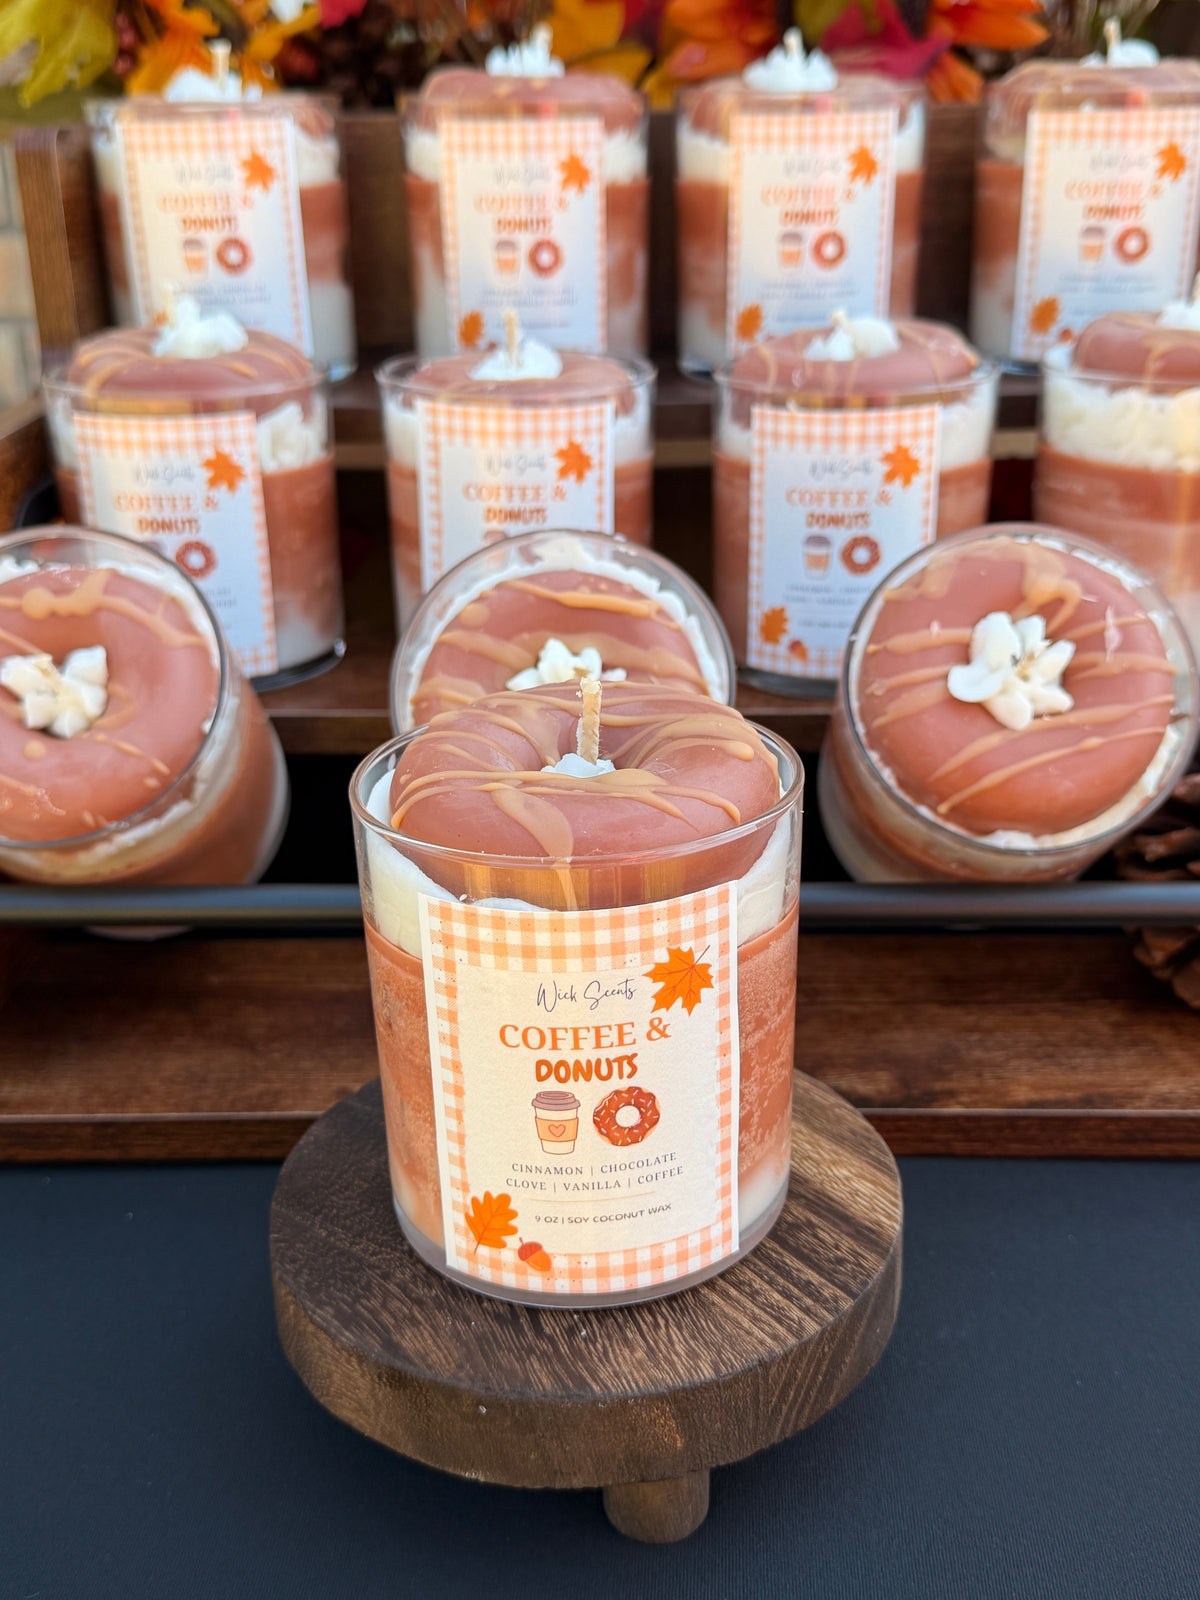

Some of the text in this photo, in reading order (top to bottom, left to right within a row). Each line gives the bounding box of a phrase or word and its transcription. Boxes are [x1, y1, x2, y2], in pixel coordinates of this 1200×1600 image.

[536, 978, 637, 1012] Wick Scents
[499, 1016, 671, 1051] COFFEE &
[535, 1052, 639, 1083] DONUTS
[512, 1162, 584, 1176] CINNAMON
[600, 1152, 678, 1174] CHOCOLATE
[505, 1178, 547, 1191] CLOVE
[563, 1179, 622, 1191] VANILLA
[637, 1166, 684, 1184] COFFEE
[535, 1215, 541, 1223] 9
[544, 1215, 559, 1224] OZ
[568, 1216, 590, 1224] SOY
[593, 1209, 645, 1223] COCONUT
[648, 1203, 672, 1215] WAX
